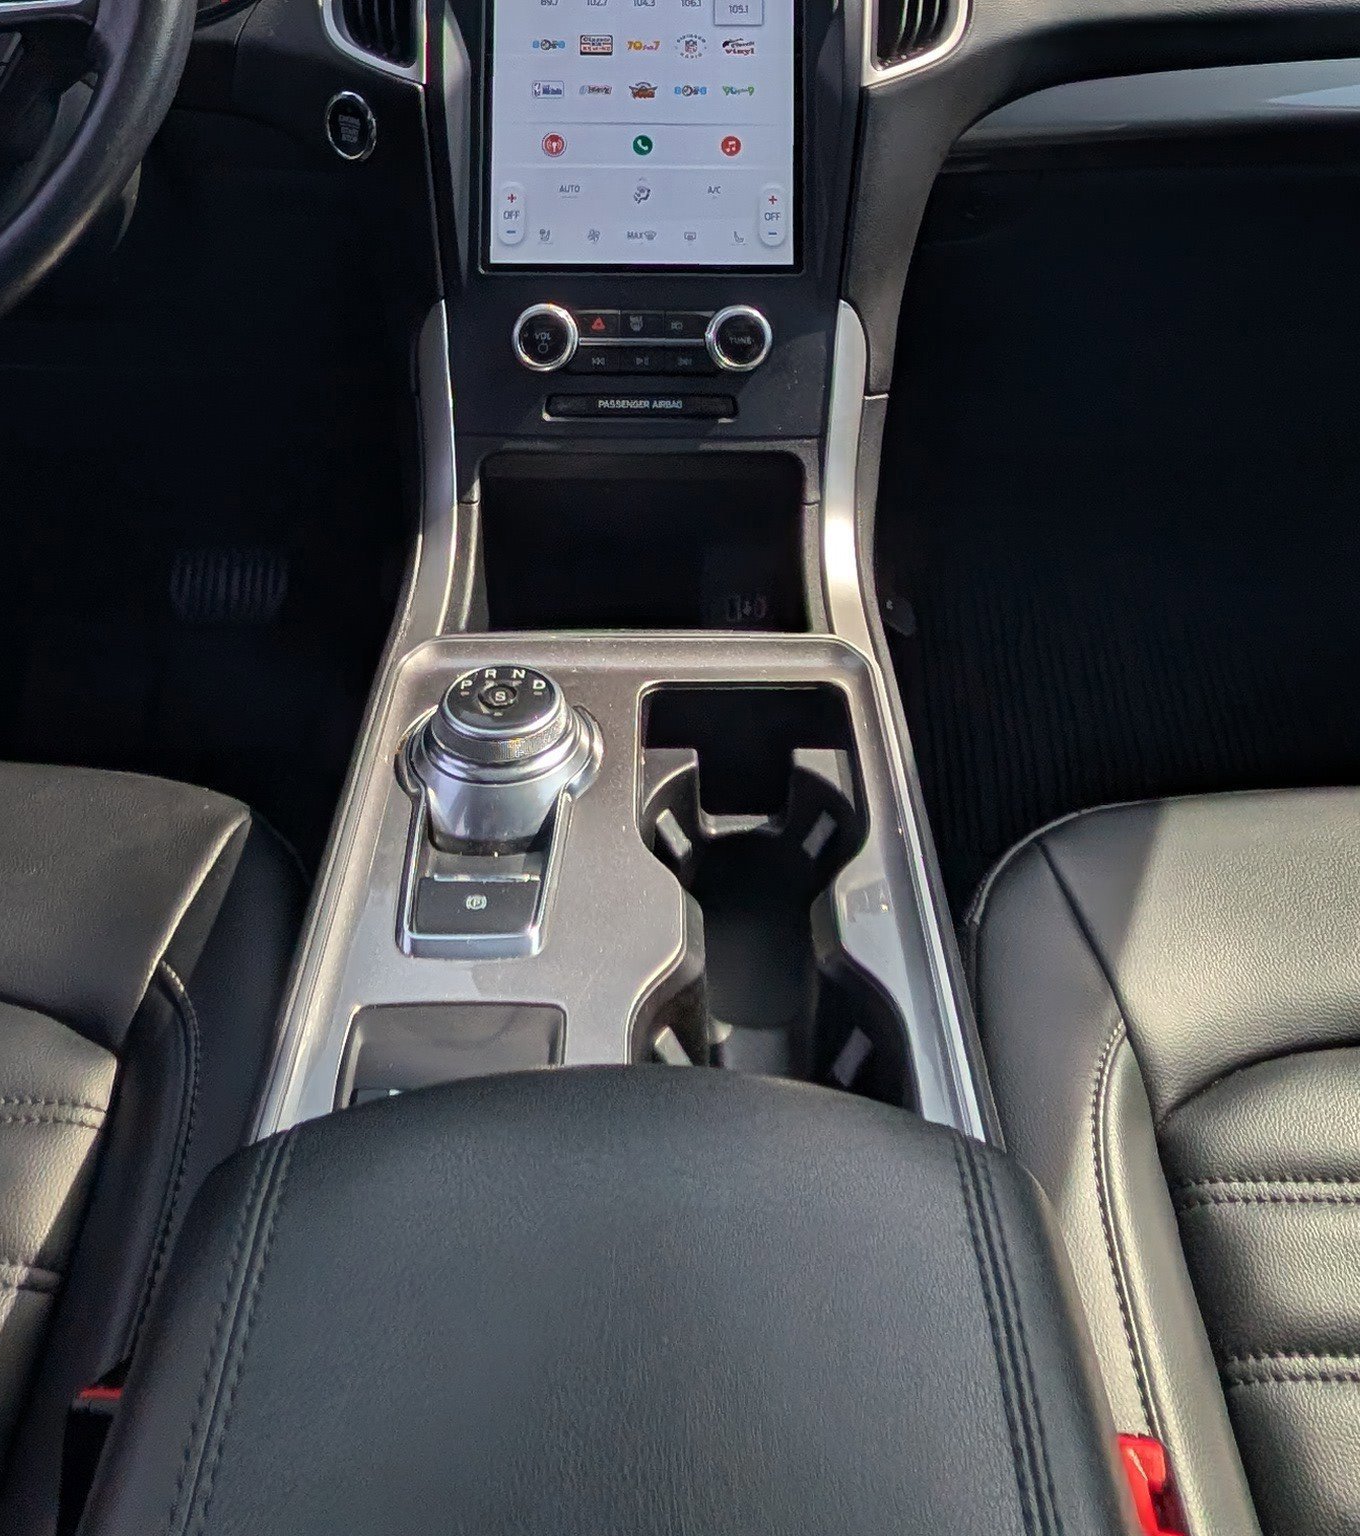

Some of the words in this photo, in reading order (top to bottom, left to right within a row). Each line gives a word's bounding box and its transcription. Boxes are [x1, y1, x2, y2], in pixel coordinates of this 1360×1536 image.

[559, 185, 581, 193] AUTO
[707, 185, 721, 194] A/C
[503, 211, 520, 220] OFF
[764, 212, 781, 221] OFF
[598, 400, 650, 409] PASSENGER
[652, 400, 682, 409] AIRBAG
[461, 680, 473, 690] P
[485, 669, 497, 679] R
[513, 669, 525, 678] N
[533, 680, 546, 689] D
[495, 691, 506, 701] S
